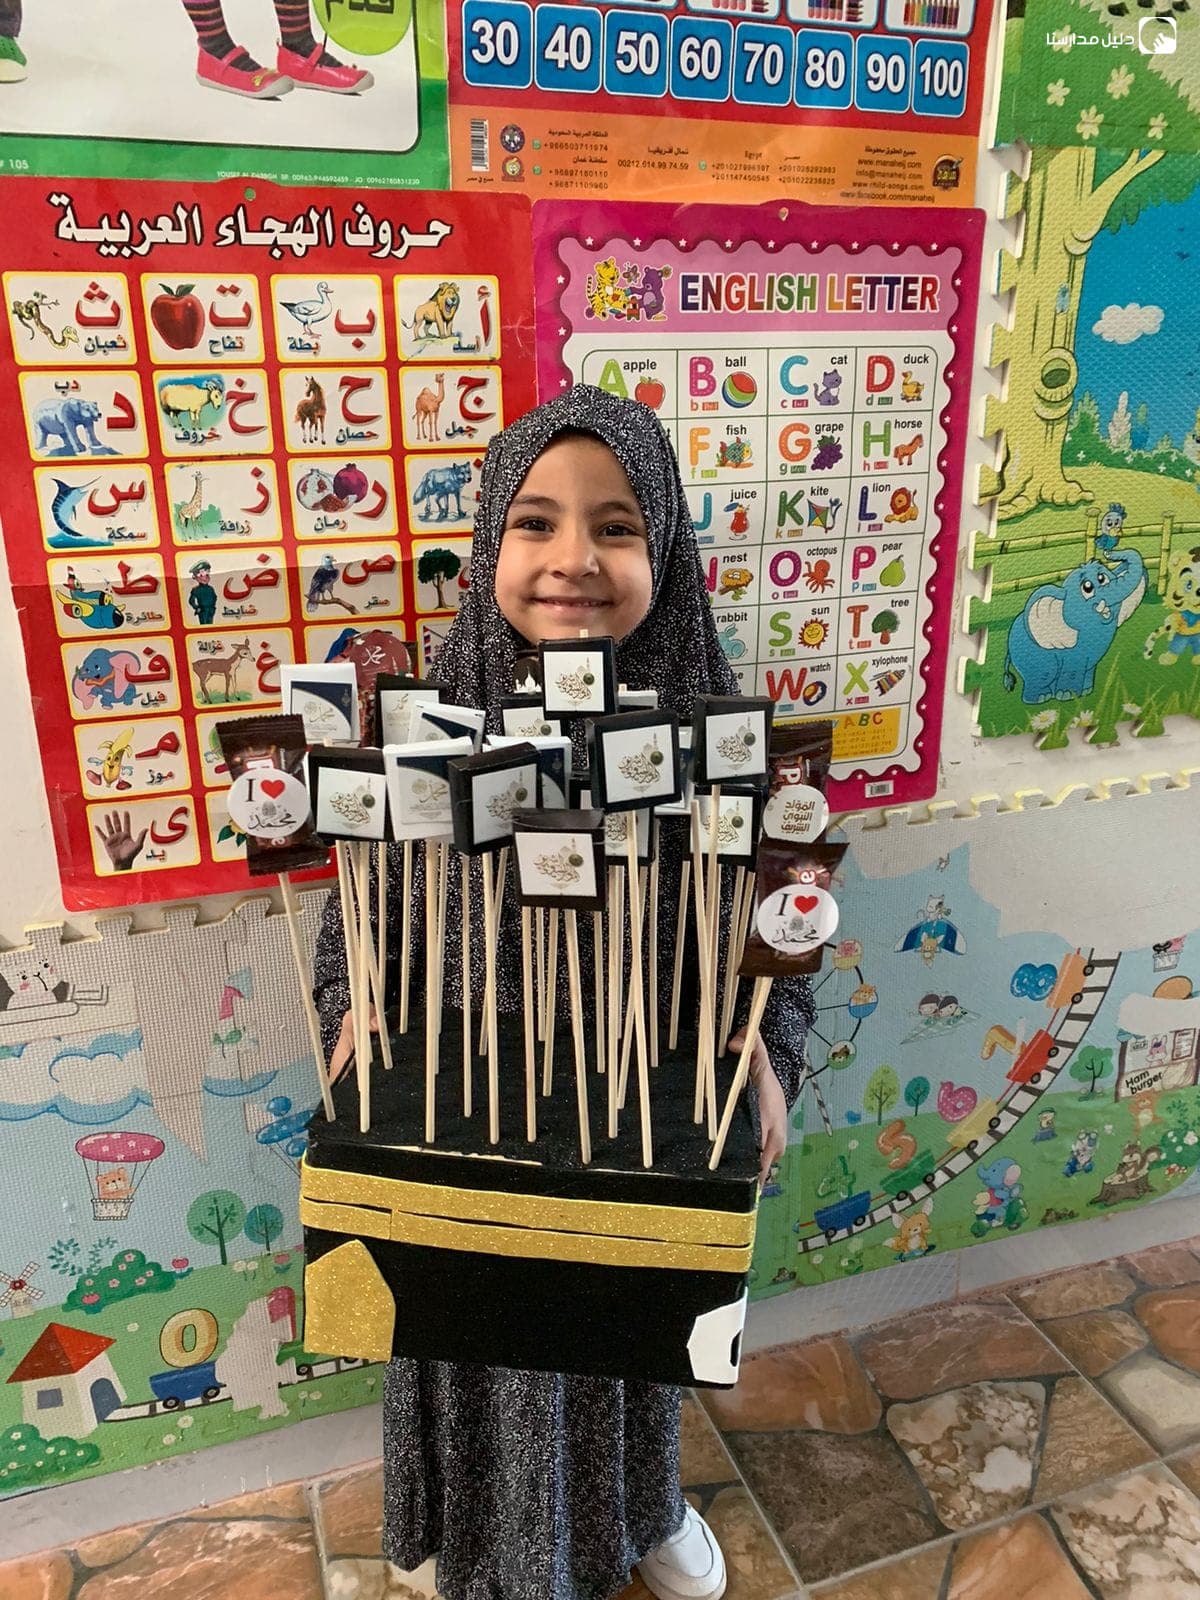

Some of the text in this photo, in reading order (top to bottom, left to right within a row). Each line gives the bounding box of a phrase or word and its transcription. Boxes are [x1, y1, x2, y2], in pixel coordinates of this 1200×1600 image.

[471, 19, 963, 98] 30 40 50 60 70 80 90 100
[8, 158, 29, 170] 105
[744, 150, 763, 160] Egypt
[48, 193, 452, 258] حروف الهجاء العربية
[680, 271, 940, 314] ENGLISH LETTER
[75, 281, 122, 327] ث
[208, 283, 252, 328] ت
[334, 308, 376, 350] ب
[84, 334, 127, 355] ثعبان
[208, 335, 244, 356] تفاح
[287, 336, 320, 356] بطة
[623, 359, 657, 373] apple
[725, 356, 747, 368] ball
[830, 354, 848, 365] cat
[903, 353, 929, 365] duck
[598, 358, 628, 399] A
[689, 356, 717, 397] B
[780, 355, 808, 395] C
[866, 354, 895, 393] D
[54, 379, 79, 395] دب
[225, 377, 267, 435] خ
[338, 375, 382, 424] ح
[457, 375, 496, 422] ج
[690, 400, 699, 411] b
[866, 394, 873, 406] d
[106, 390, 136, 430] د
[445, 421, 478, 439] جمل
[726, 424, 747, 435] fish
[815, 423, 844, 435] grape
[894, 419, 923, 429] horse
[175, 426, 221, 445] خروف
[335, 426, 379, 444] حصان
[779, 422, 811, 462] G
[863, 420, 891, 458] H
[689, 426, 711, 466] F
[780, 462, 788, 475] g
[863, 460, 870, 471] h
[240, 466, 270, 514] ز
[730, 489, 757, 502] juice
[810, 486, 829, 497] kite
[872, 482, 891, 493] lion
[87, 479, 146, 516] س
[353, 480, 388, 519] ر
[859, 485, 878, 521] L
[692, 492, 712, 531] J
[778, 490, 805, 527] K
[105, 526, 147, 541] سمكة
[219, 519, 252, 536] زرافة
[313, 516, 347, 533] رمان
[775, 528, 783, 539] k
[806, 546, 838, 557] octopus
[882, 542, 903, 553] pear
[723, 552, 747, 563] nest
[852, 545, 876, 580] P
[112, 560, 159, 595] ط
[223, 552, 280, 600] ض
[342, 554, 396, 585] ص
[769, 550, 802, 587] O
[222, 604, 257, 619] ضابط
[365, 595, 391, 609] صقر
[811, 606, 830, 616] sun
[891, 599, 910, 608] tree
[126, 611, 165, 624] طائرة
[717, 612, 748, 623] rabbit
[847, 604, 869, 638] T
[768, 611, 792, 647] S
[197, 640, 223, 654] غزالة
[124, 646, 171, 683] ف
[256, 641, 281, 693] غ
[810, 663, 831, 673] watch
[872, 655, 908, 668] xylophone
[766, 667, 807, 702] W
[843, 660, 869, 695] X
[140, 690, 167, 706] فيل
[147, 769, 174, 785] موز
[246, 778, 256, 802] I
[247, 812, 297, 831] محمد
[146, 849, 167, 862] يد
[776, 893, 792, 917] I
[772, 927, 820, 945] محمد
[1125, 1070, 1150, 1089] Ham
[1130, 1071, 1163, 1095] burger
[876, 1118, 918, 1170] 5
